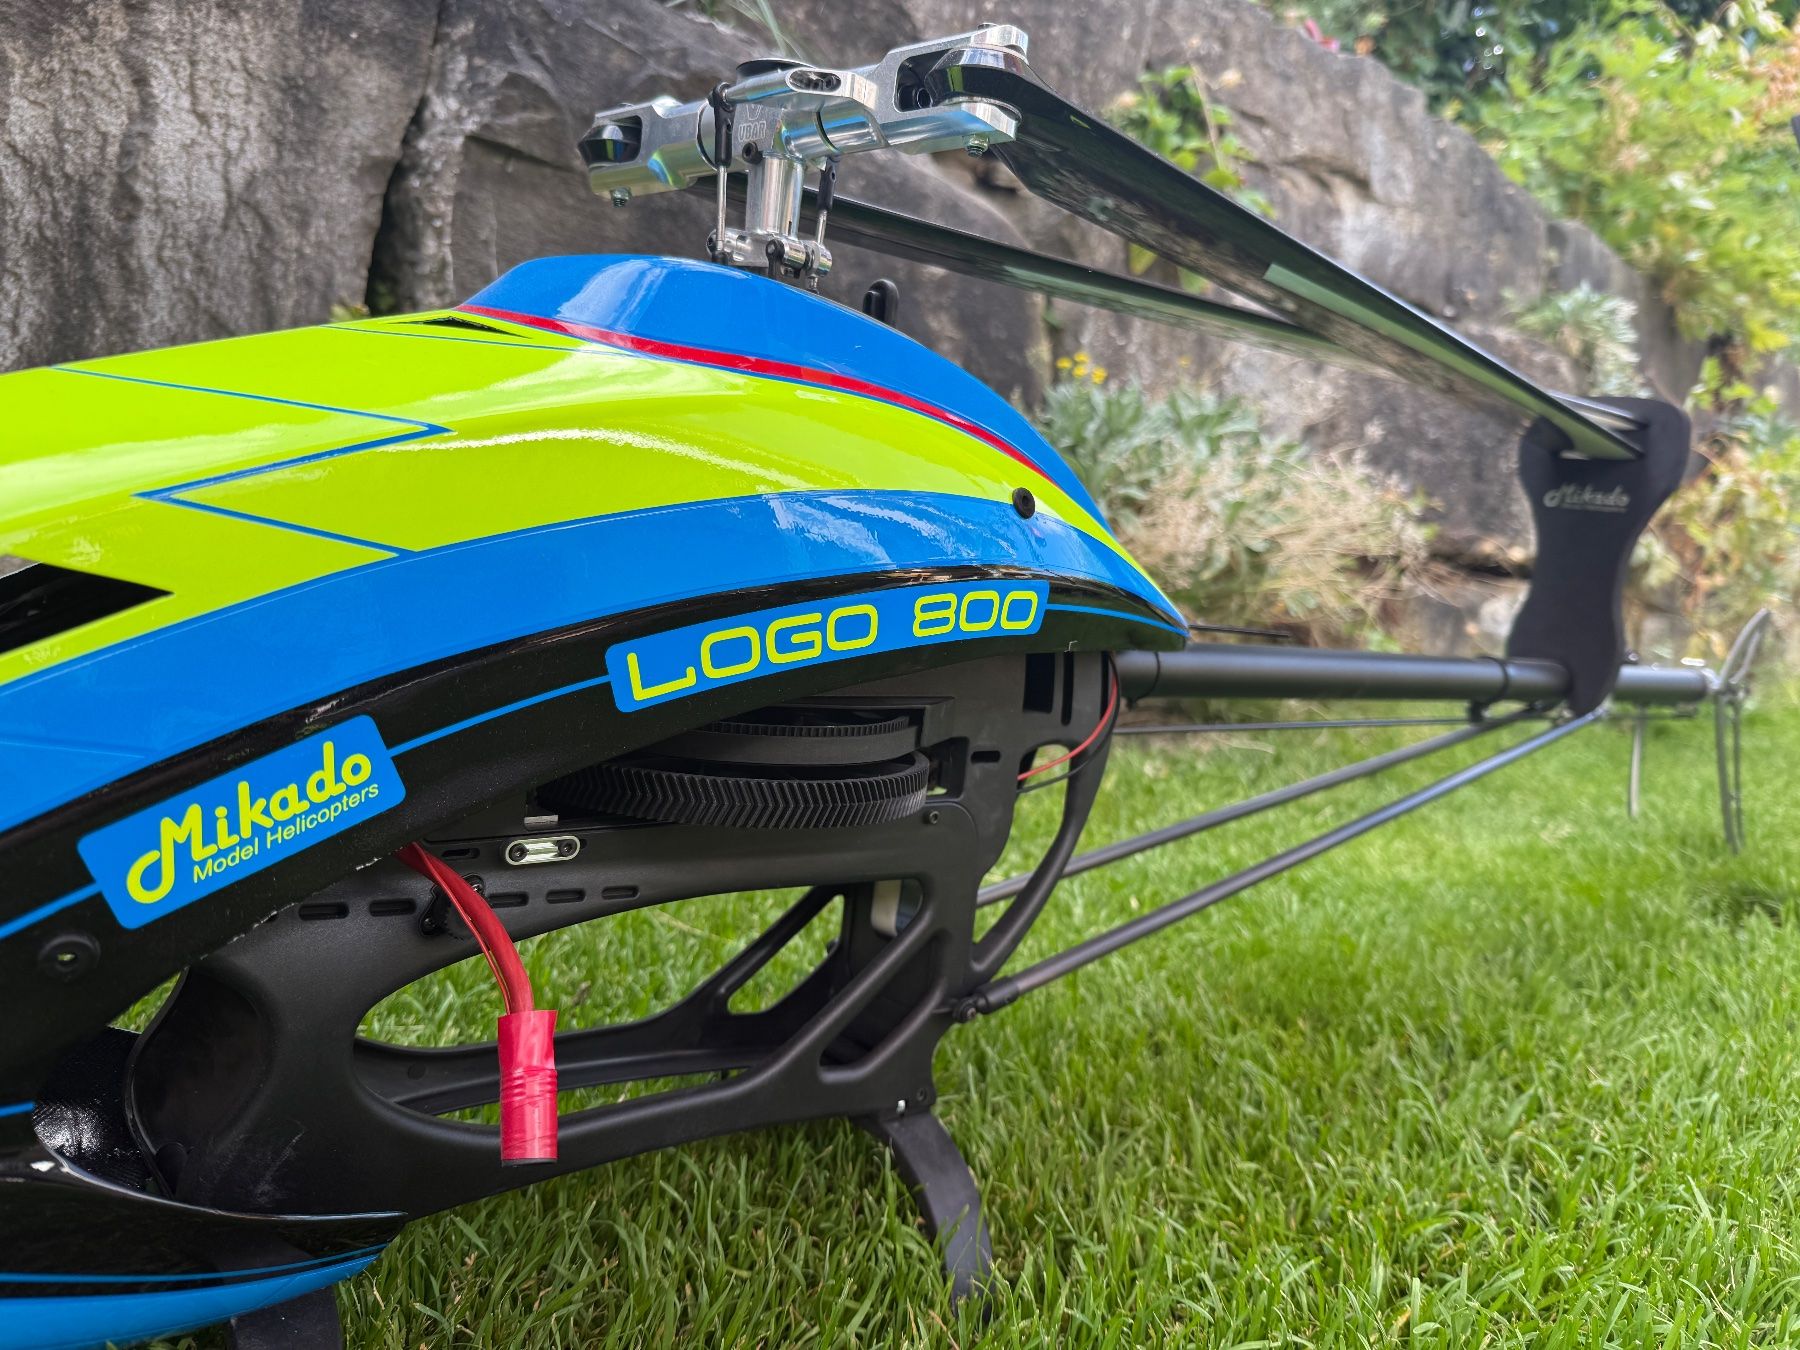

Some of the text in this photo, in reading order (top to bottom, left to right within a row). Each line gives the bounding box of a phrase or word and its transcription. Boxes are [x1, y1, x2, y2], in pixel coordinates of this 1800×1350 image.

[627, 590, 1039, 701] LOGO 800
[126, 741, 371, 904] Mikado
[193, 783, 379, 883] Model Helicopters
